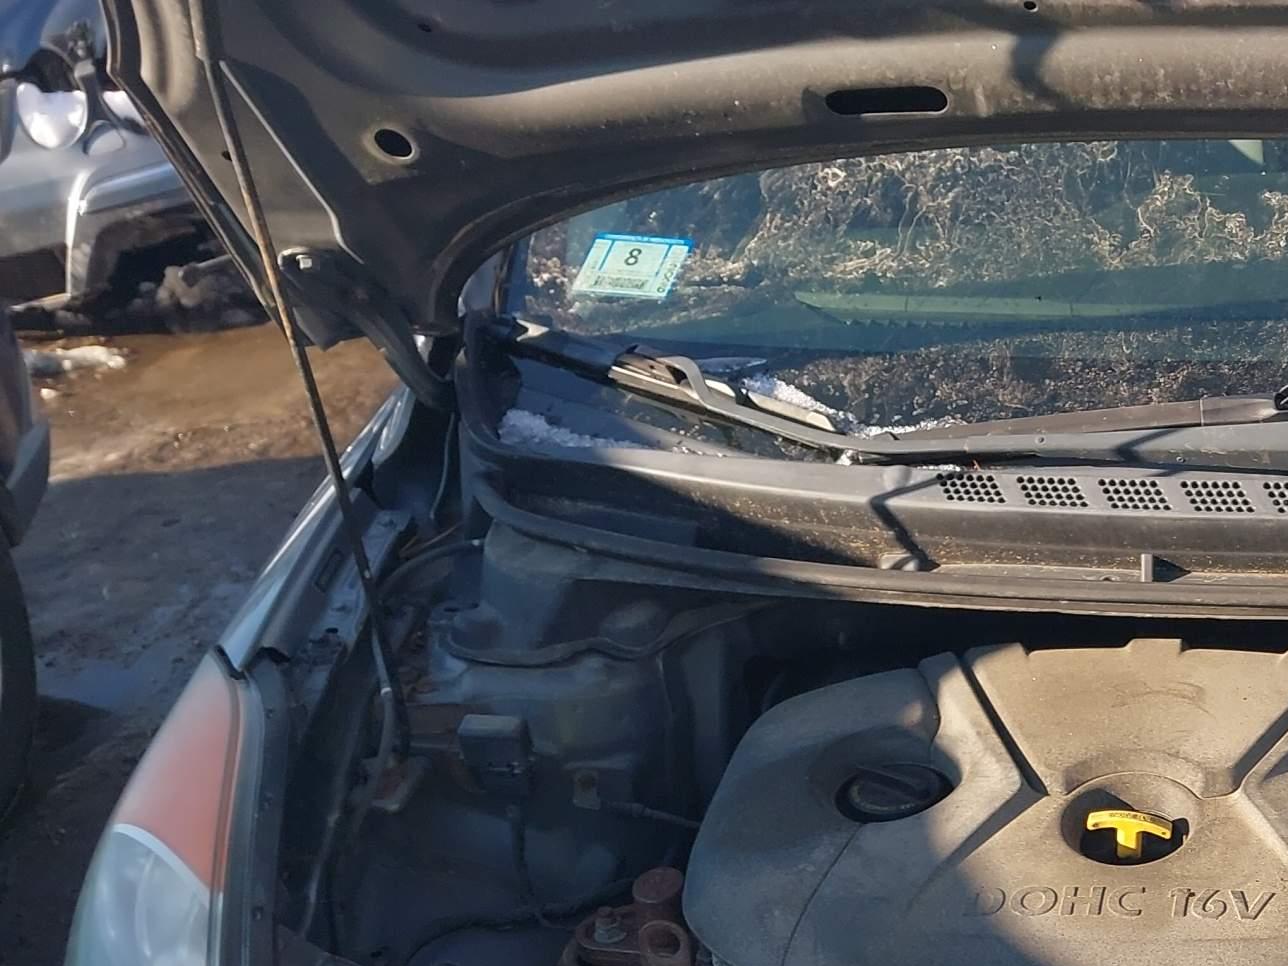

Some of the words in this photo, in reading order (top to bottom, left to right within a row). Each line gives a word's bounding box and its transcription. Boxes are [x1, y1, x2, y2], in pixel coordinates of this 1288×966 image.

[624, 247, 642, 266] 8
[962, 886, 1146, 917] DOHC
[1169, 888, 1277, 920] 16V
